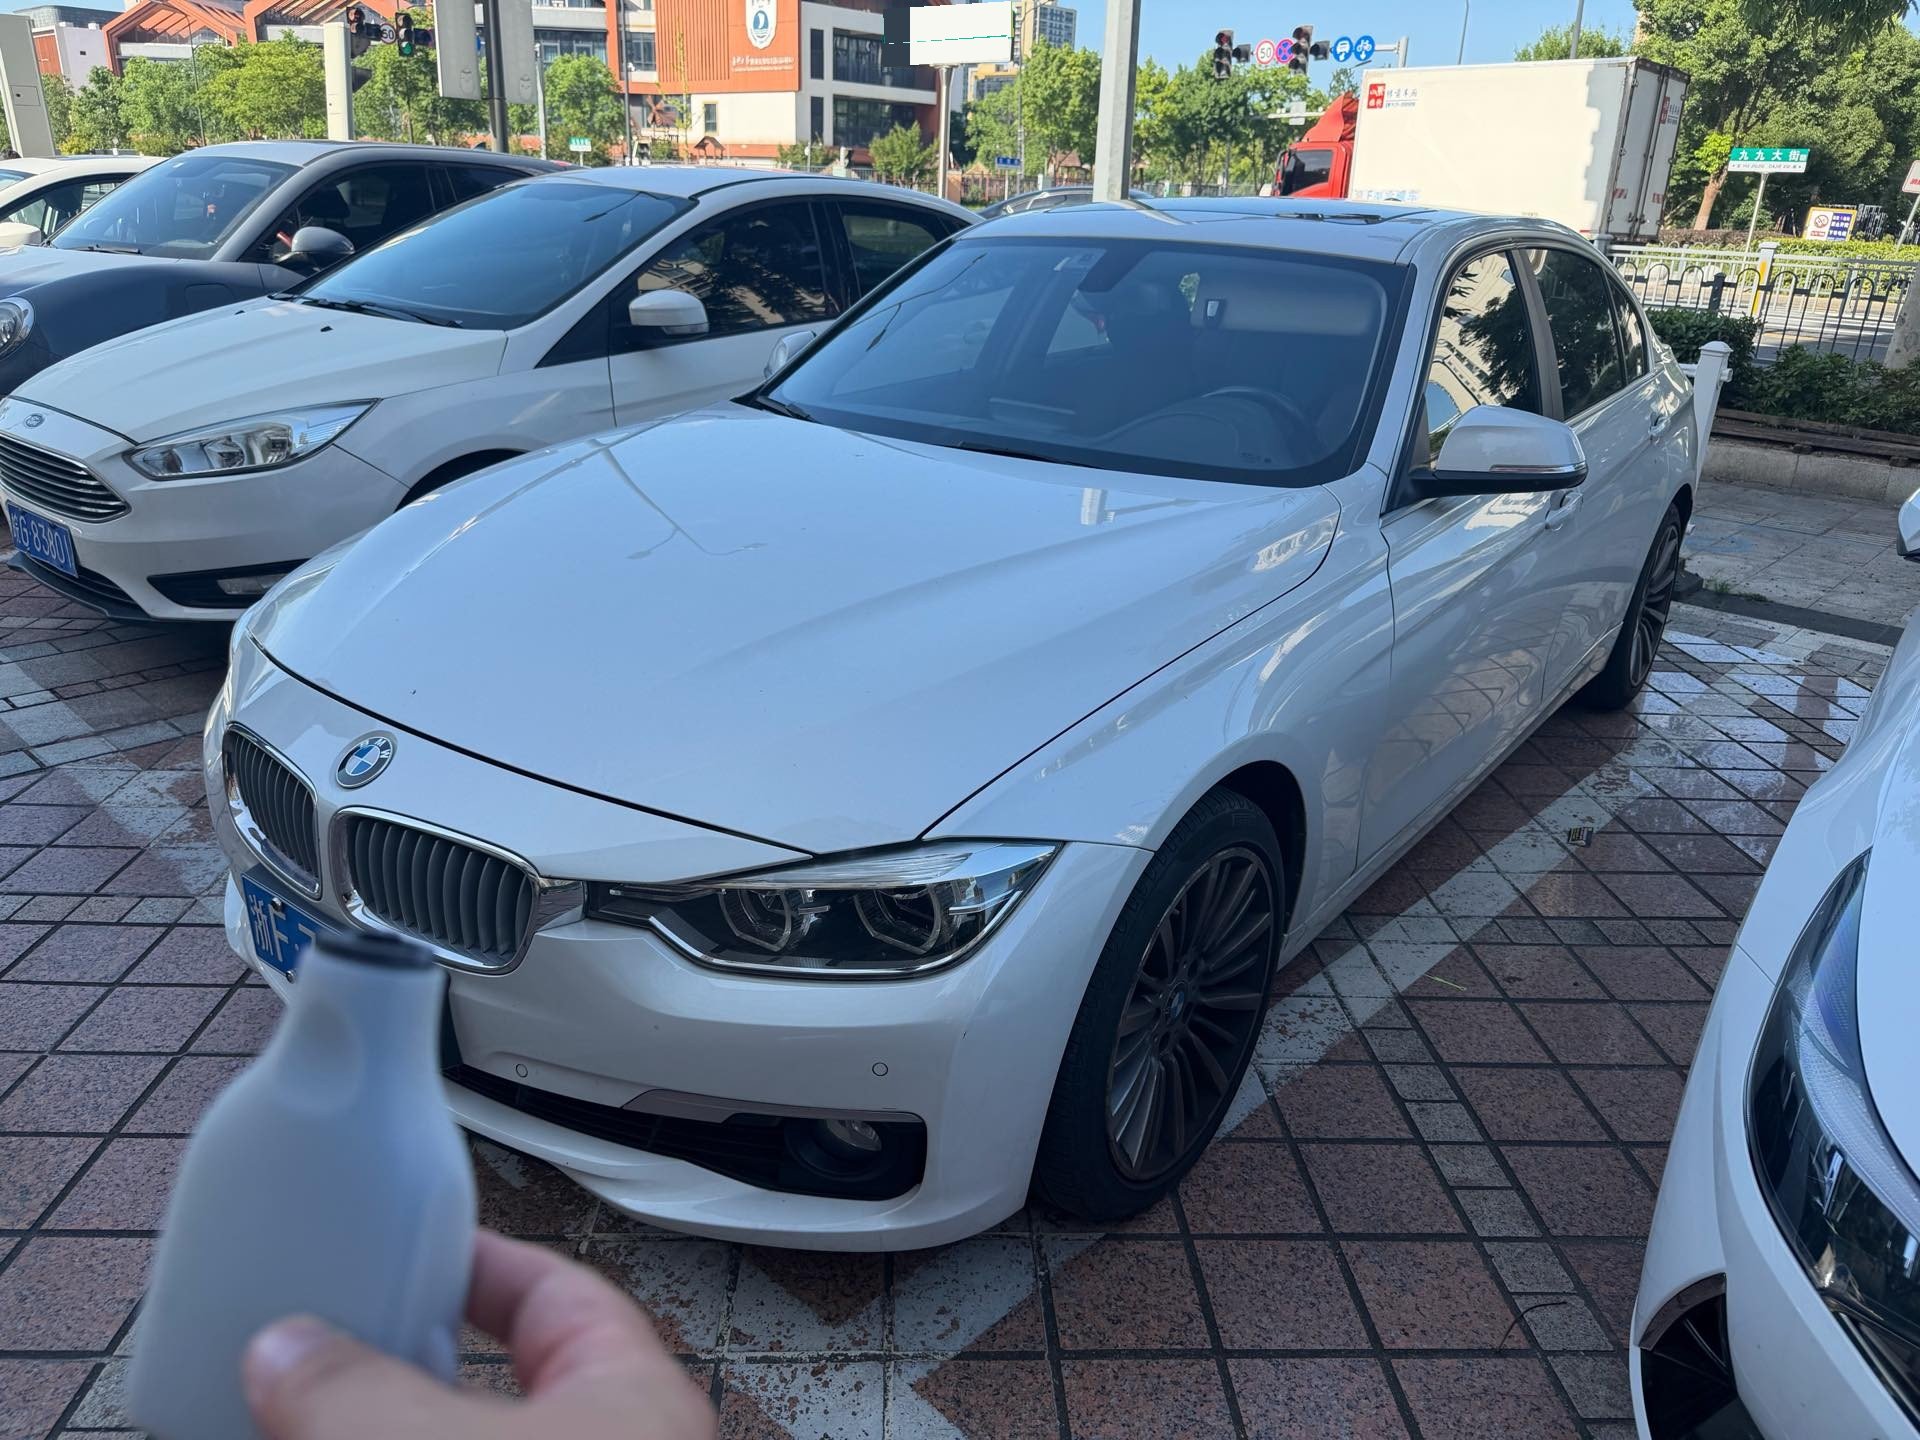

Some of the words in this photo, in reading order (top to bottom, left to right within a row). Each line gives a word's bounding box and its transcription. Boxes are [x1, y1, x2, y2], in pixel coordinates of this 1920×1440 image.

[1260, 47, 1272, 59] 50
[1738, 149, 1801, 161] 九九大街
